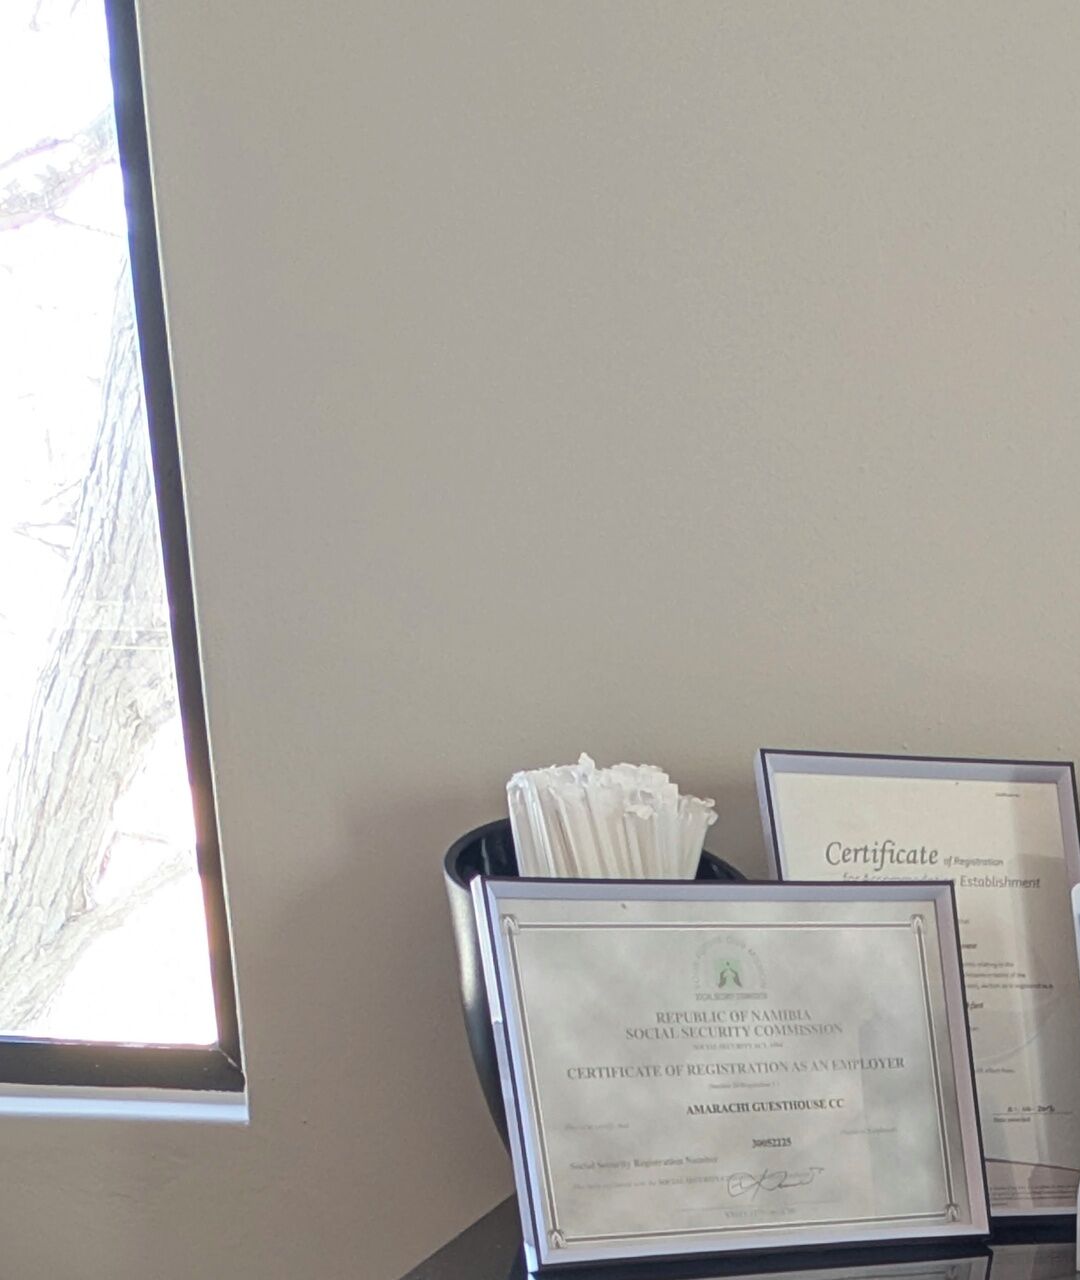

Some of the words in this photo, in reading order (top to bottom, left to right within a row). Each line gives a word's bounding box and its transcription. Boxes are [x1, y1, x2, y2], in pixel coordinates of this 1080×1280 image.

[825, 840, 939, 872] Certificate
[943, 856, 953, 868] of
[959, 874, 1041, 889] Establishment
[656, 1011, 727, 1025] REPUBLIC
[729, 1010, 748, 1023] OF
[750, 1009, 812, 1022] NAMIBIA
[625, 1027, 679, 1041] SOCIAL
[680, 1026, 750, 1039] SECURITY
[753, 1023, 844, 1037] COMMISSION
[567, 1065, 662, 1080] CERTIFICATE
[665, 1064, 685, 1077] OF
[686, 1060, 789, 1076] REGISTRATION
[791, 1061, 808, 1073] AS
[809, 1060, 829, 1072] AN
[831, 1057, 905, 1071] EMPLOYER
[686, 1102, 750, 1116] AMARACHI
[751, 1100, 827, 1113] GUESTHOUSE
[828, 1098, 845, 1109] CC
